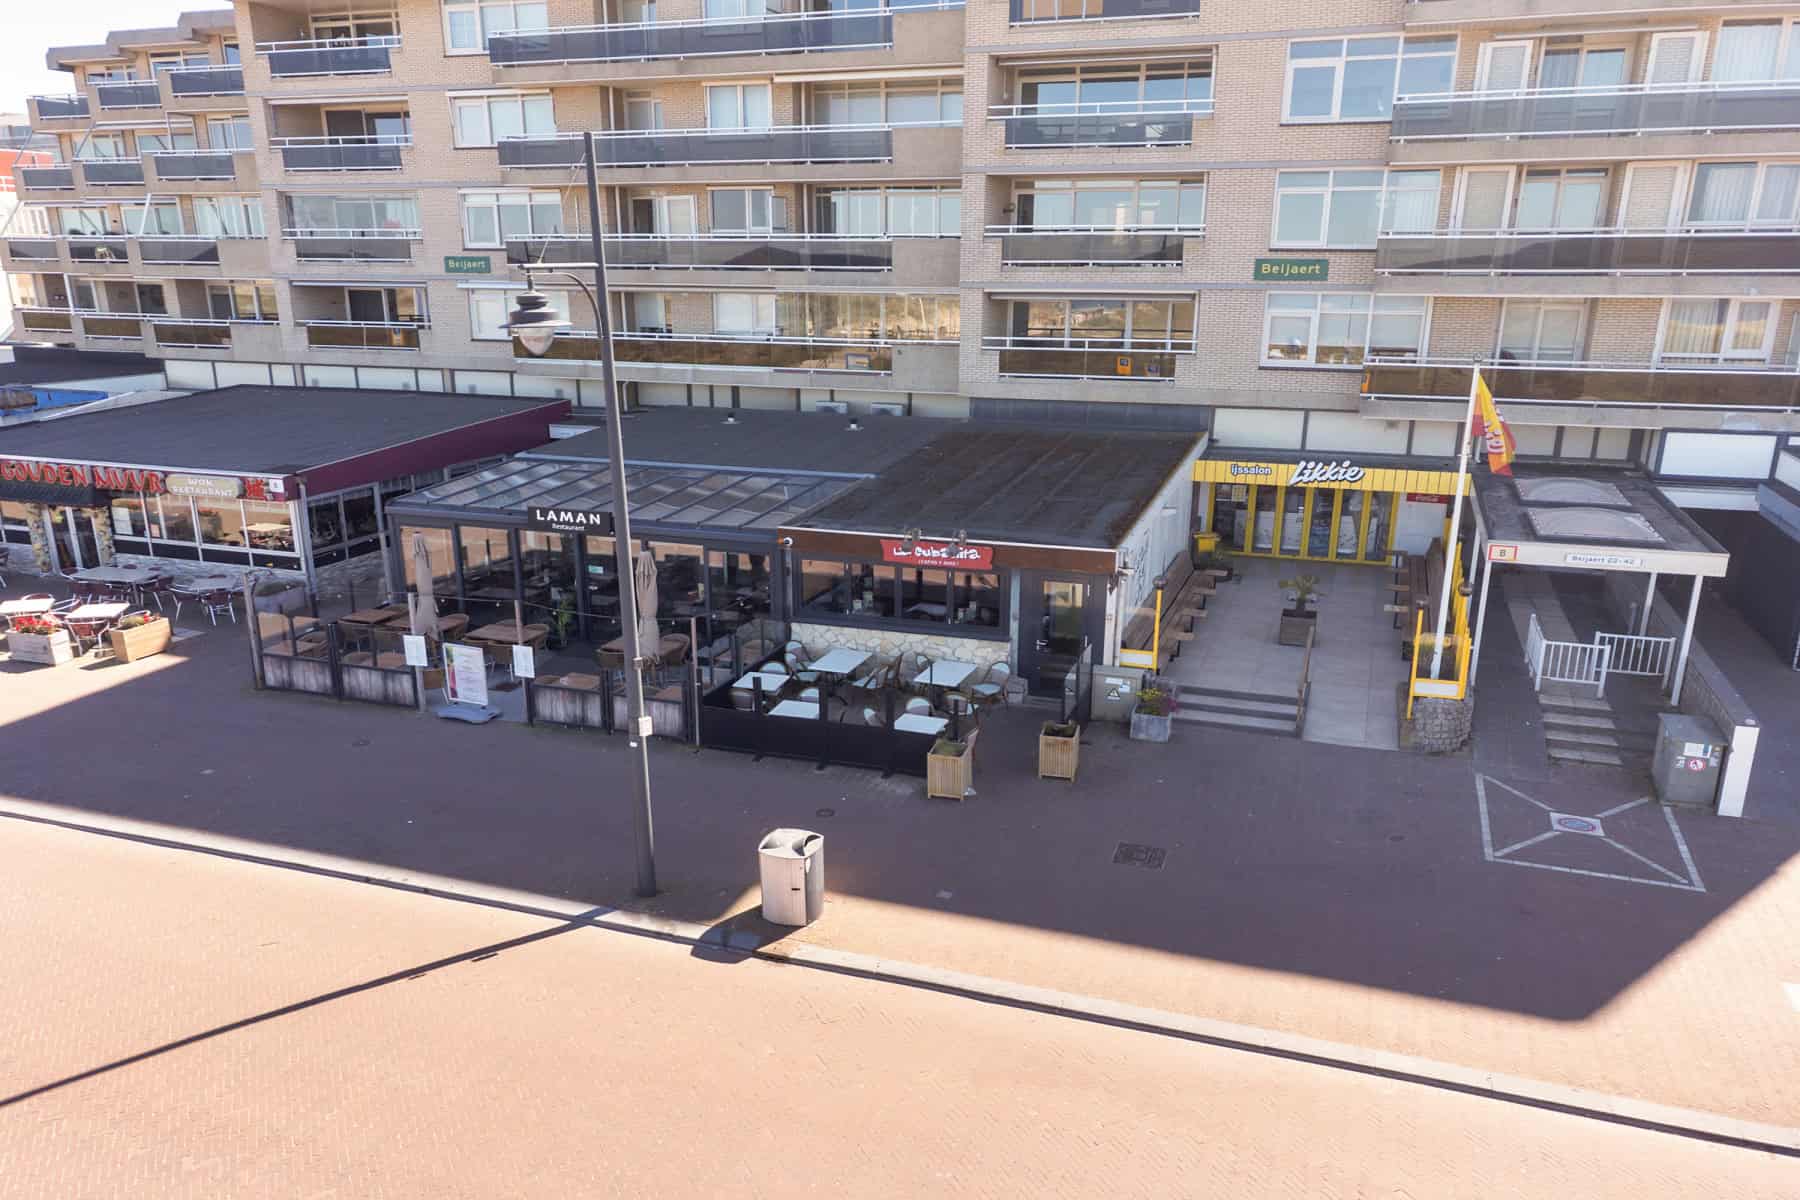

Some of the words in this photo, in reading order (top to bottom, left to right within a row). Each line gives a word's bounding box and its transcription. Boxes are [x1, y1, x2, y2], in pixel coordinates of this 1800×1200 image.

[1261, 263, 1321, 276] Beijaert
[0, 461, 89, 488] GOUDEN
[1288, 460, 1365, 486] Likkie
[536, 509, 600, 525] LAMAN
